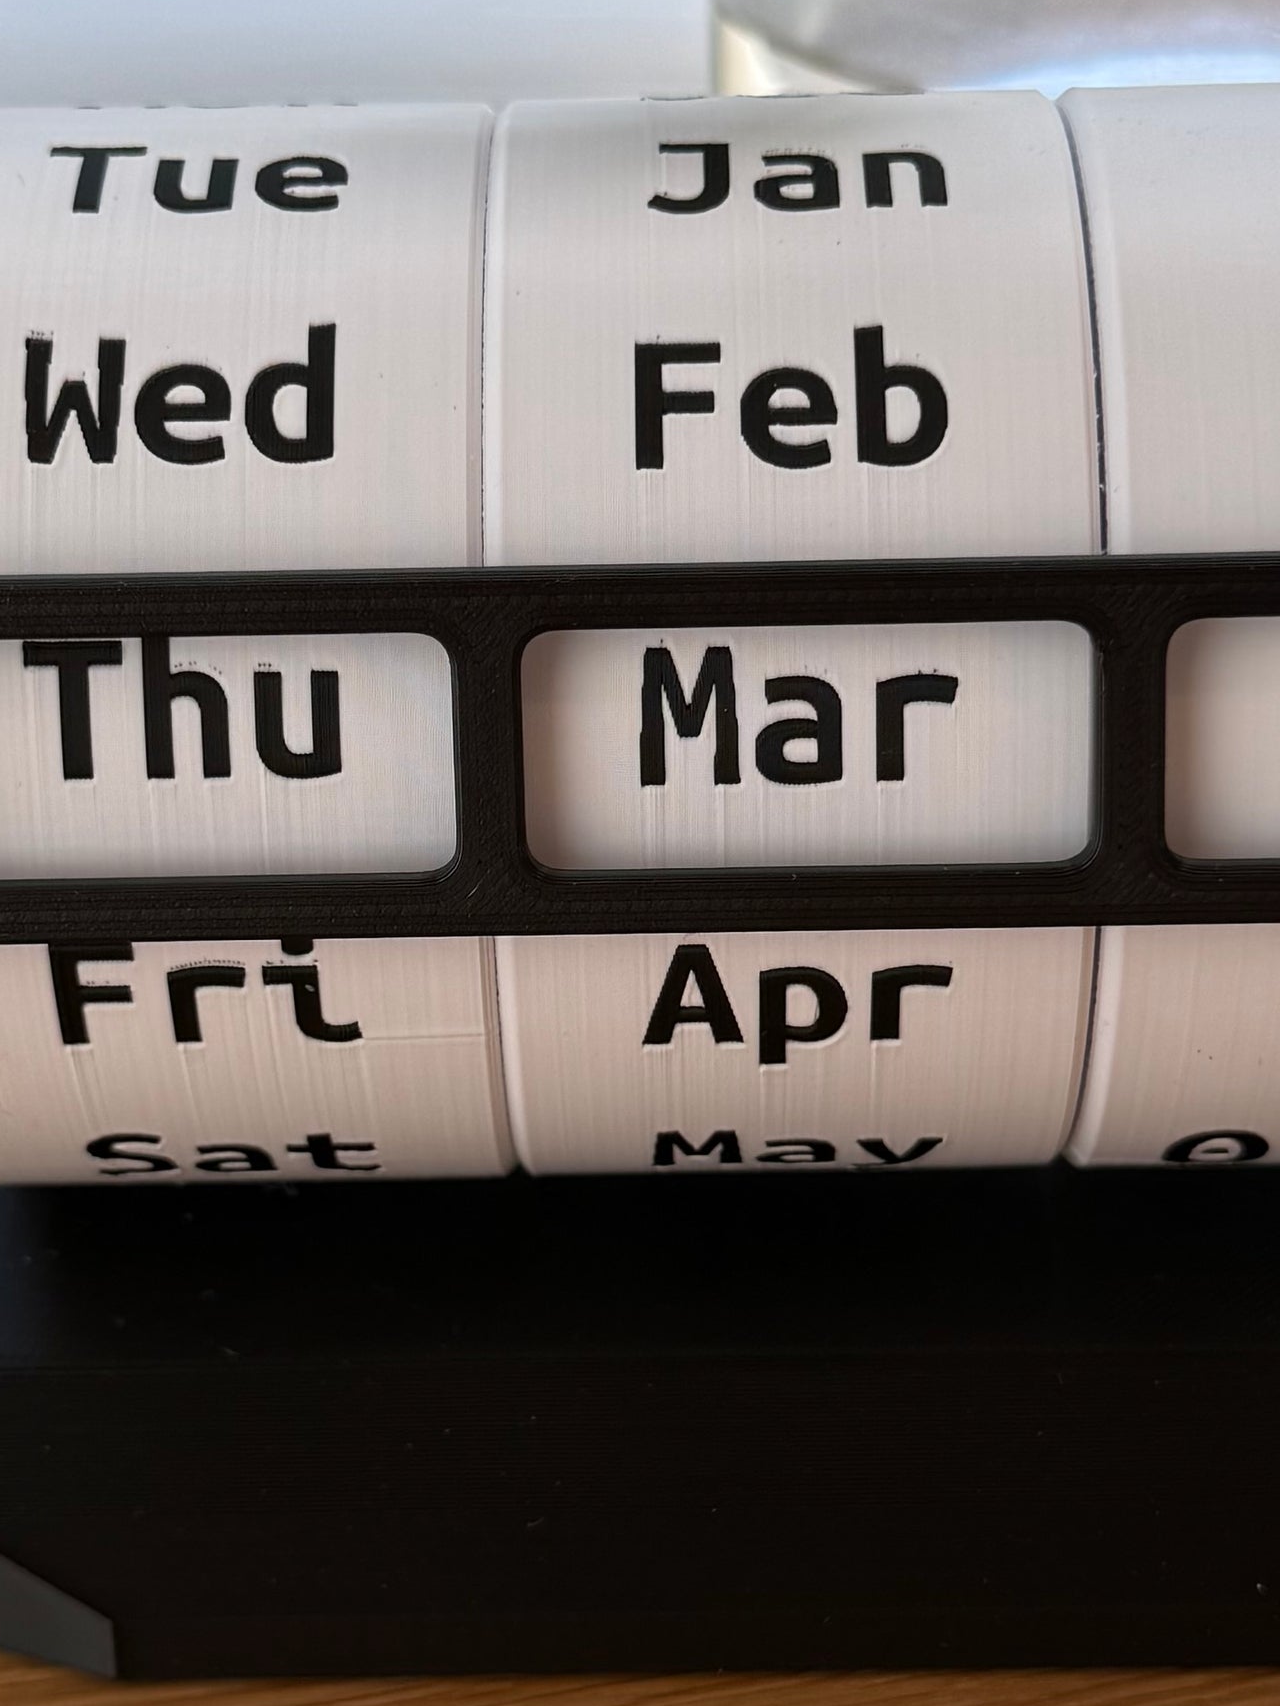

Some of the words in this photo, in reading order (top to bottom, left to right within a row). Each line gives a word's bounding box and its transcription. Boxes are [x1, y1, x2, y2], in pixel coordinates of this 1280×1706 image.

[50, 145, 349, 214] Tue
[647, 143, 948, 214] Jan
[24, 323, 337, 465] Wed
[634, 325, 949, 469] Feb
[22, 637, 343, 781] Thu
[639, 644, 959, 786] Mar
[48, 940, 363, 1046] Fri
[642, 943, 953, 1065] Apr
[86, 1132, 382, 1175] Sat
[653, 1130, 945, 1169] May
